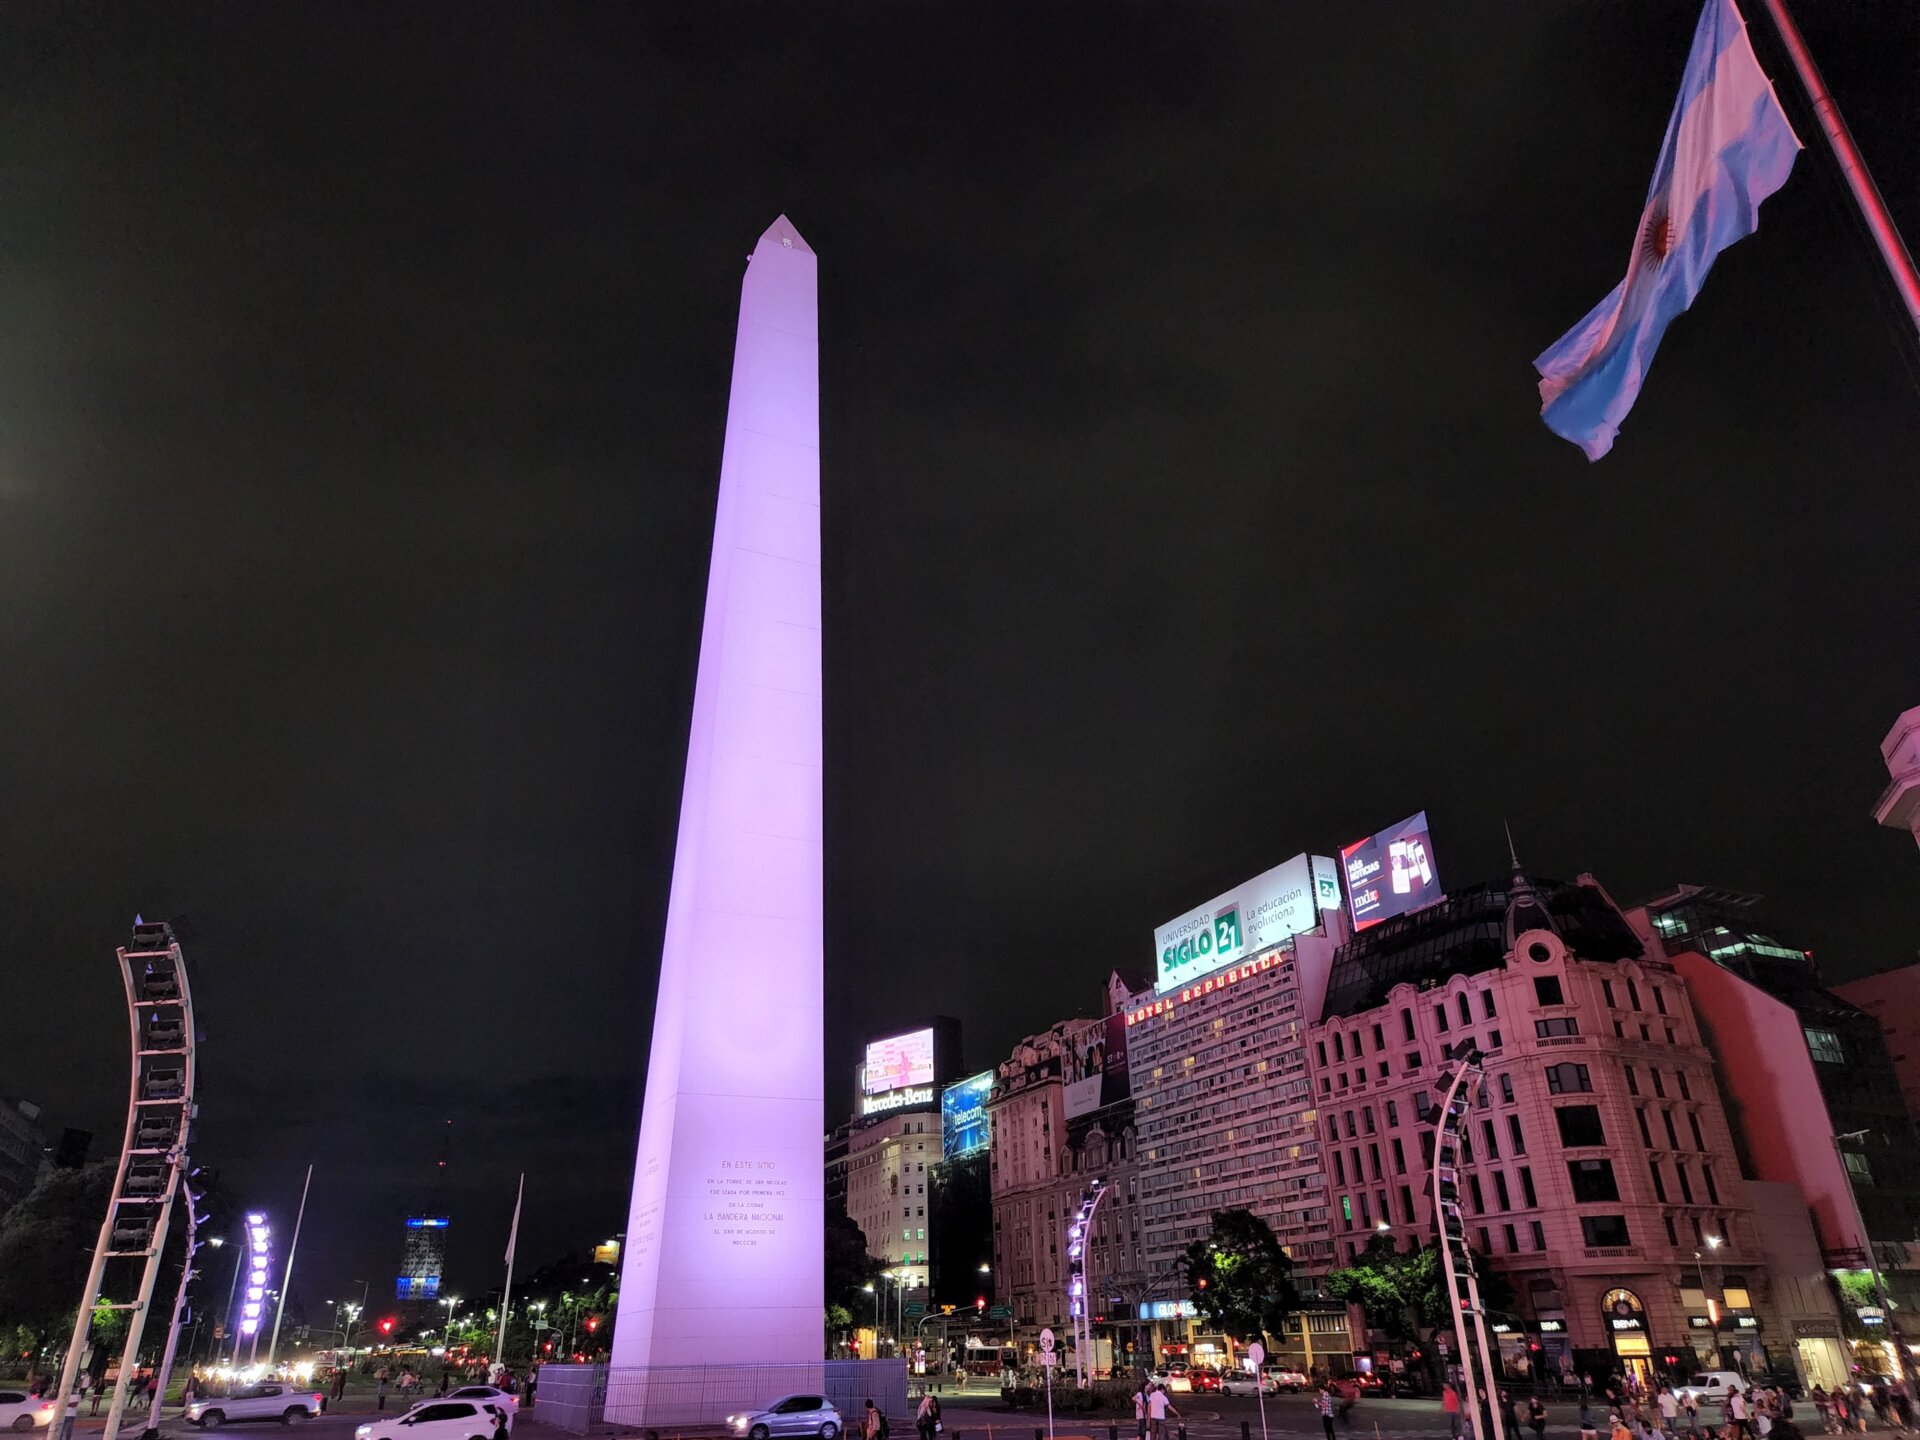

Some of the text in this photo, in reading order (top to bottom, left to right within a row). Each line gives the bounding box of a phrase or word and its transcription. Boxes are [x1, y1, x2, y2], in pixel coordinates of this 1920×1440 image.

[1318, 872, 1334, 880] SIGLO
[1350, 860, 1380, 882] NOTICIAS
[1246, 887, 1302, 922] La educación
[1162, 913, 1210, 945] UNIVERSIDAD
[1248, 905, 1295, 934] evoluciona
[1163, 921, 1236, 973] SIGLO 21
[1127, 951, 1284, 1026] HOTEL REPUBLICA
[863, 1088, 934, 1115] Mercedes-Benz
[954, 1105, 982, 1126] telecom
[721, 1160, 776, 1170] EN ESTE SITIO
[704, 1213, 785, 1222] LA BANDERA NACIONAL
[1540, 1321, 1561, 1331] BBVA
[1612, 1318, 1640, 1329] BBVA
